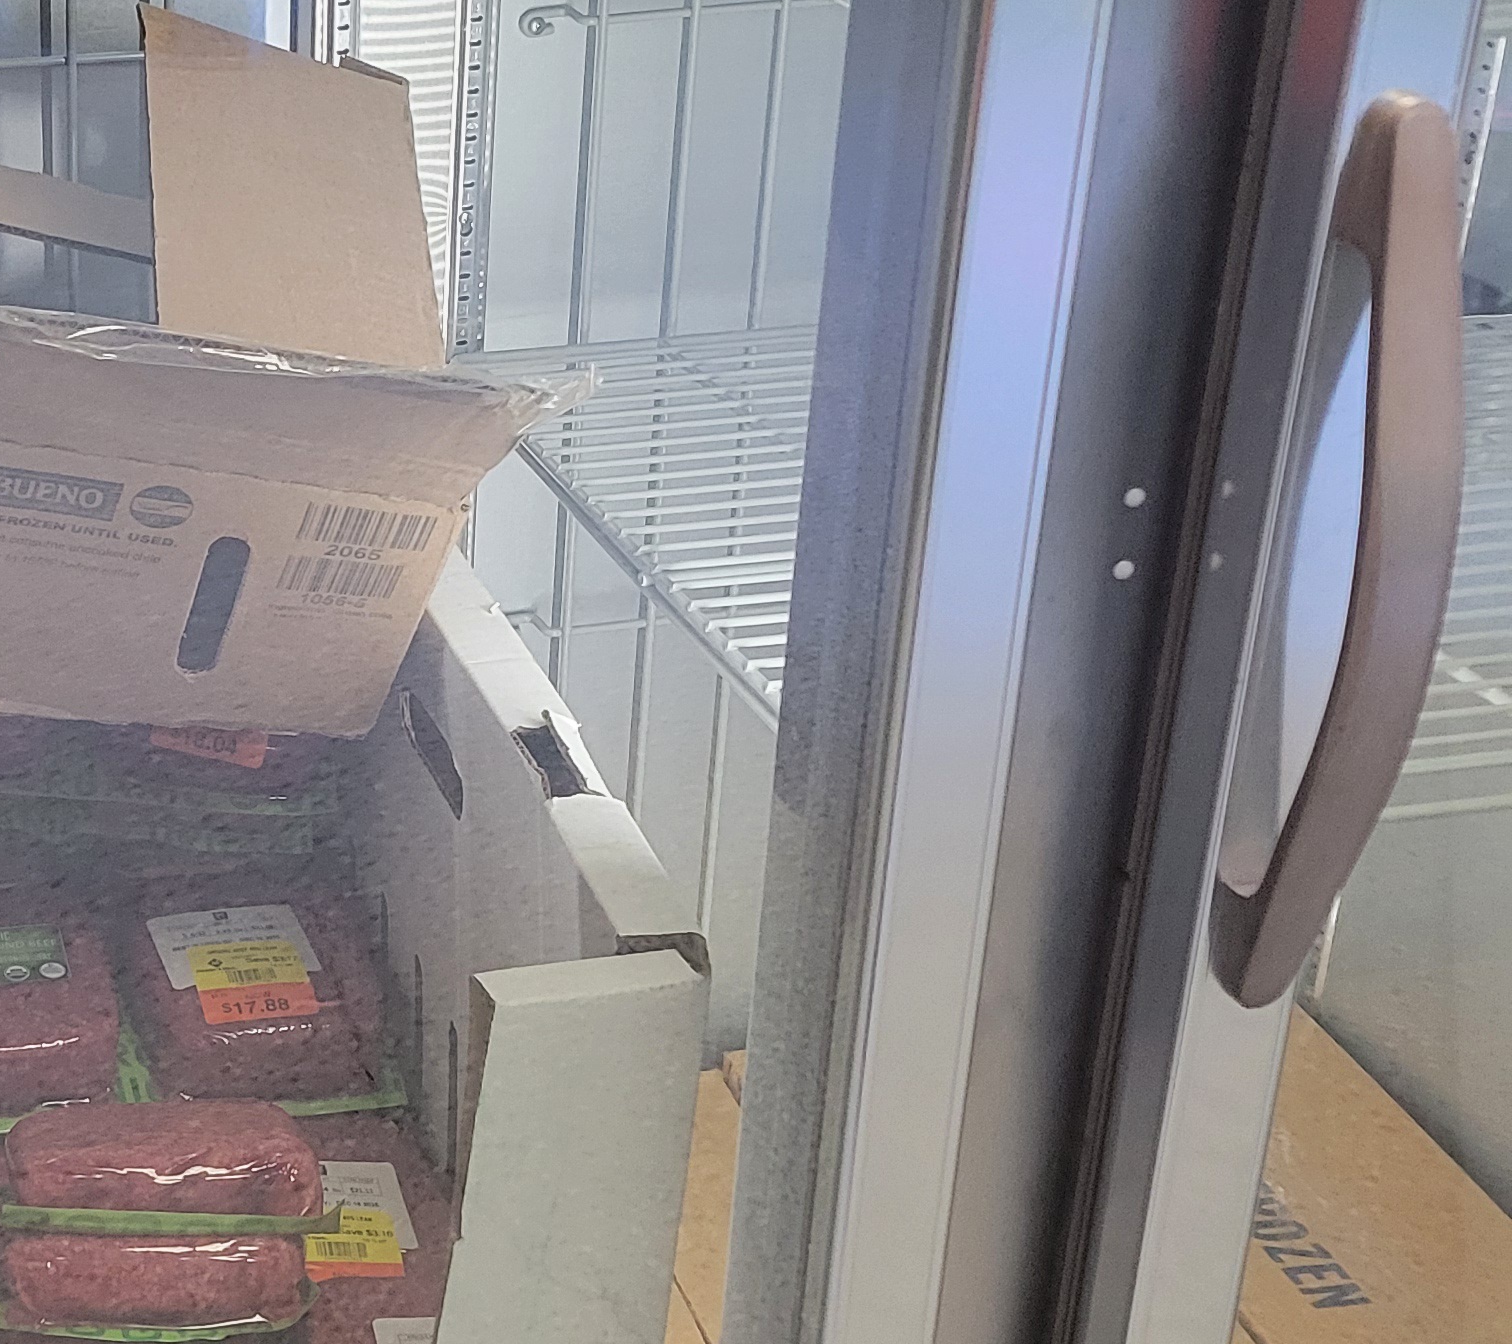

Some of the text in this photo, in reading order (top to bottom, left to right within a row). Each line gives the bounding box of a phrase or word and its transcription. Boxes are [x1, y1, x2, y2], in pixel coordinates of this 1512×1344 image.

[70, 522, 122, 540] UNTIL
[127, 531, 179, 548] USED.
[324, 544, 385, 562] 2065
[221, 997, 291, 1016] $17.88
